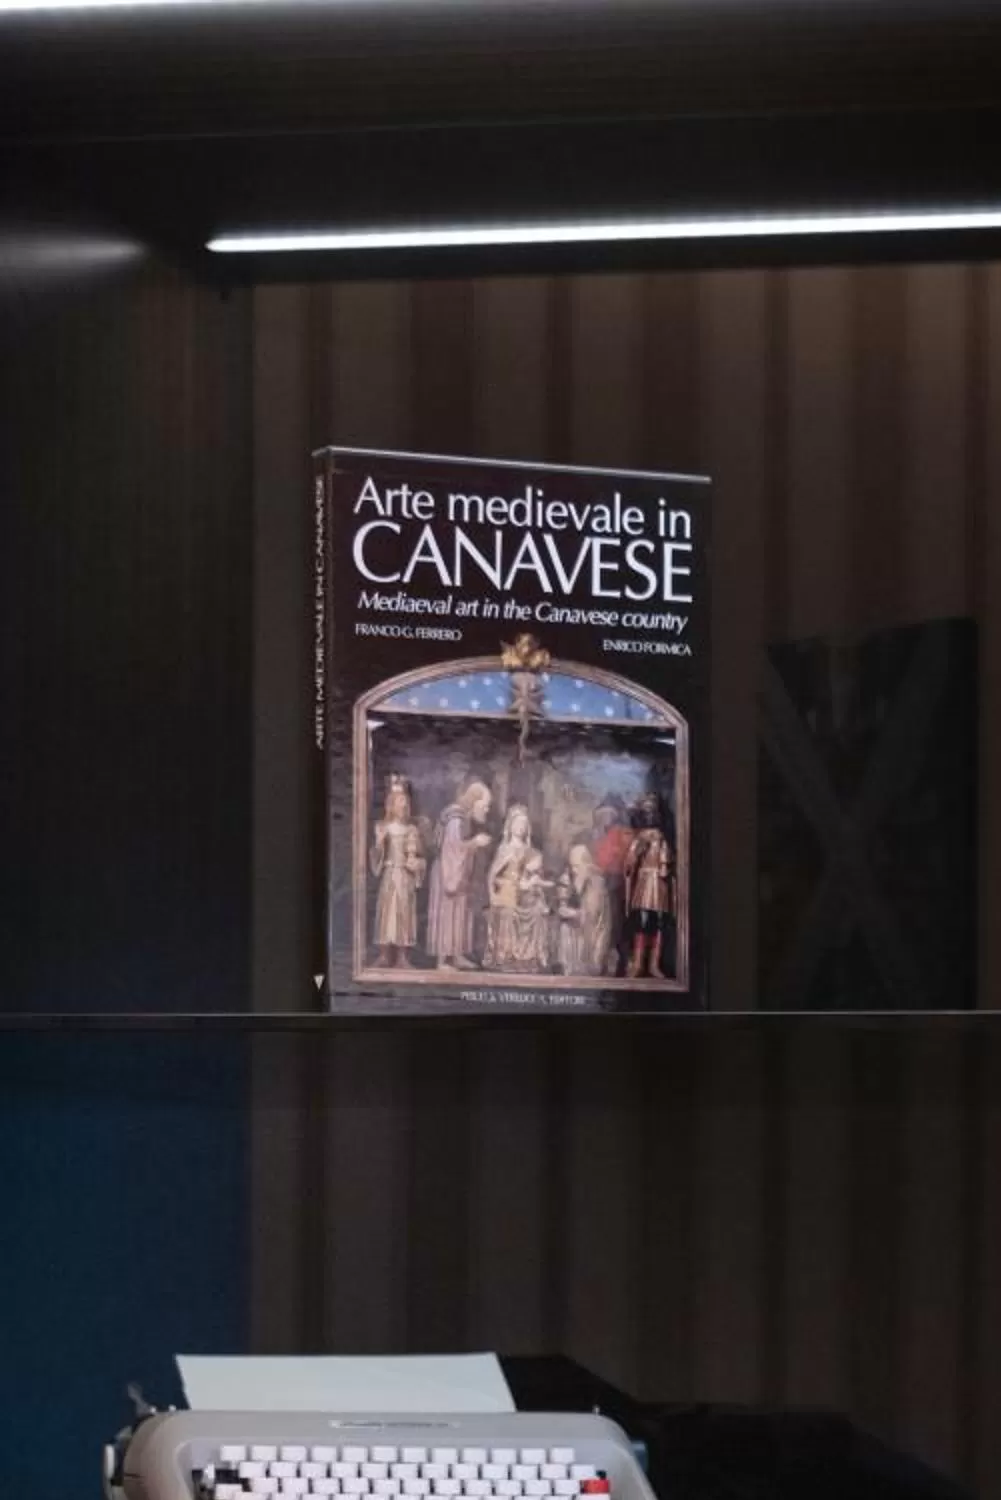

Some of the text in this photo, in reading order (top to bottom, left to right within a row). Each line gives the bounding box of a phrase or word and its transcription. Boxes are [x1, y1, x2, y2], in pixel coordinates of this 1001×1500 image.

[353, 476, 691, 538] Arte medievale in
[353, 520, 693, 603] CANAVESE
[357, 591, 689, 635] Mediaeval art in the Canavese country
